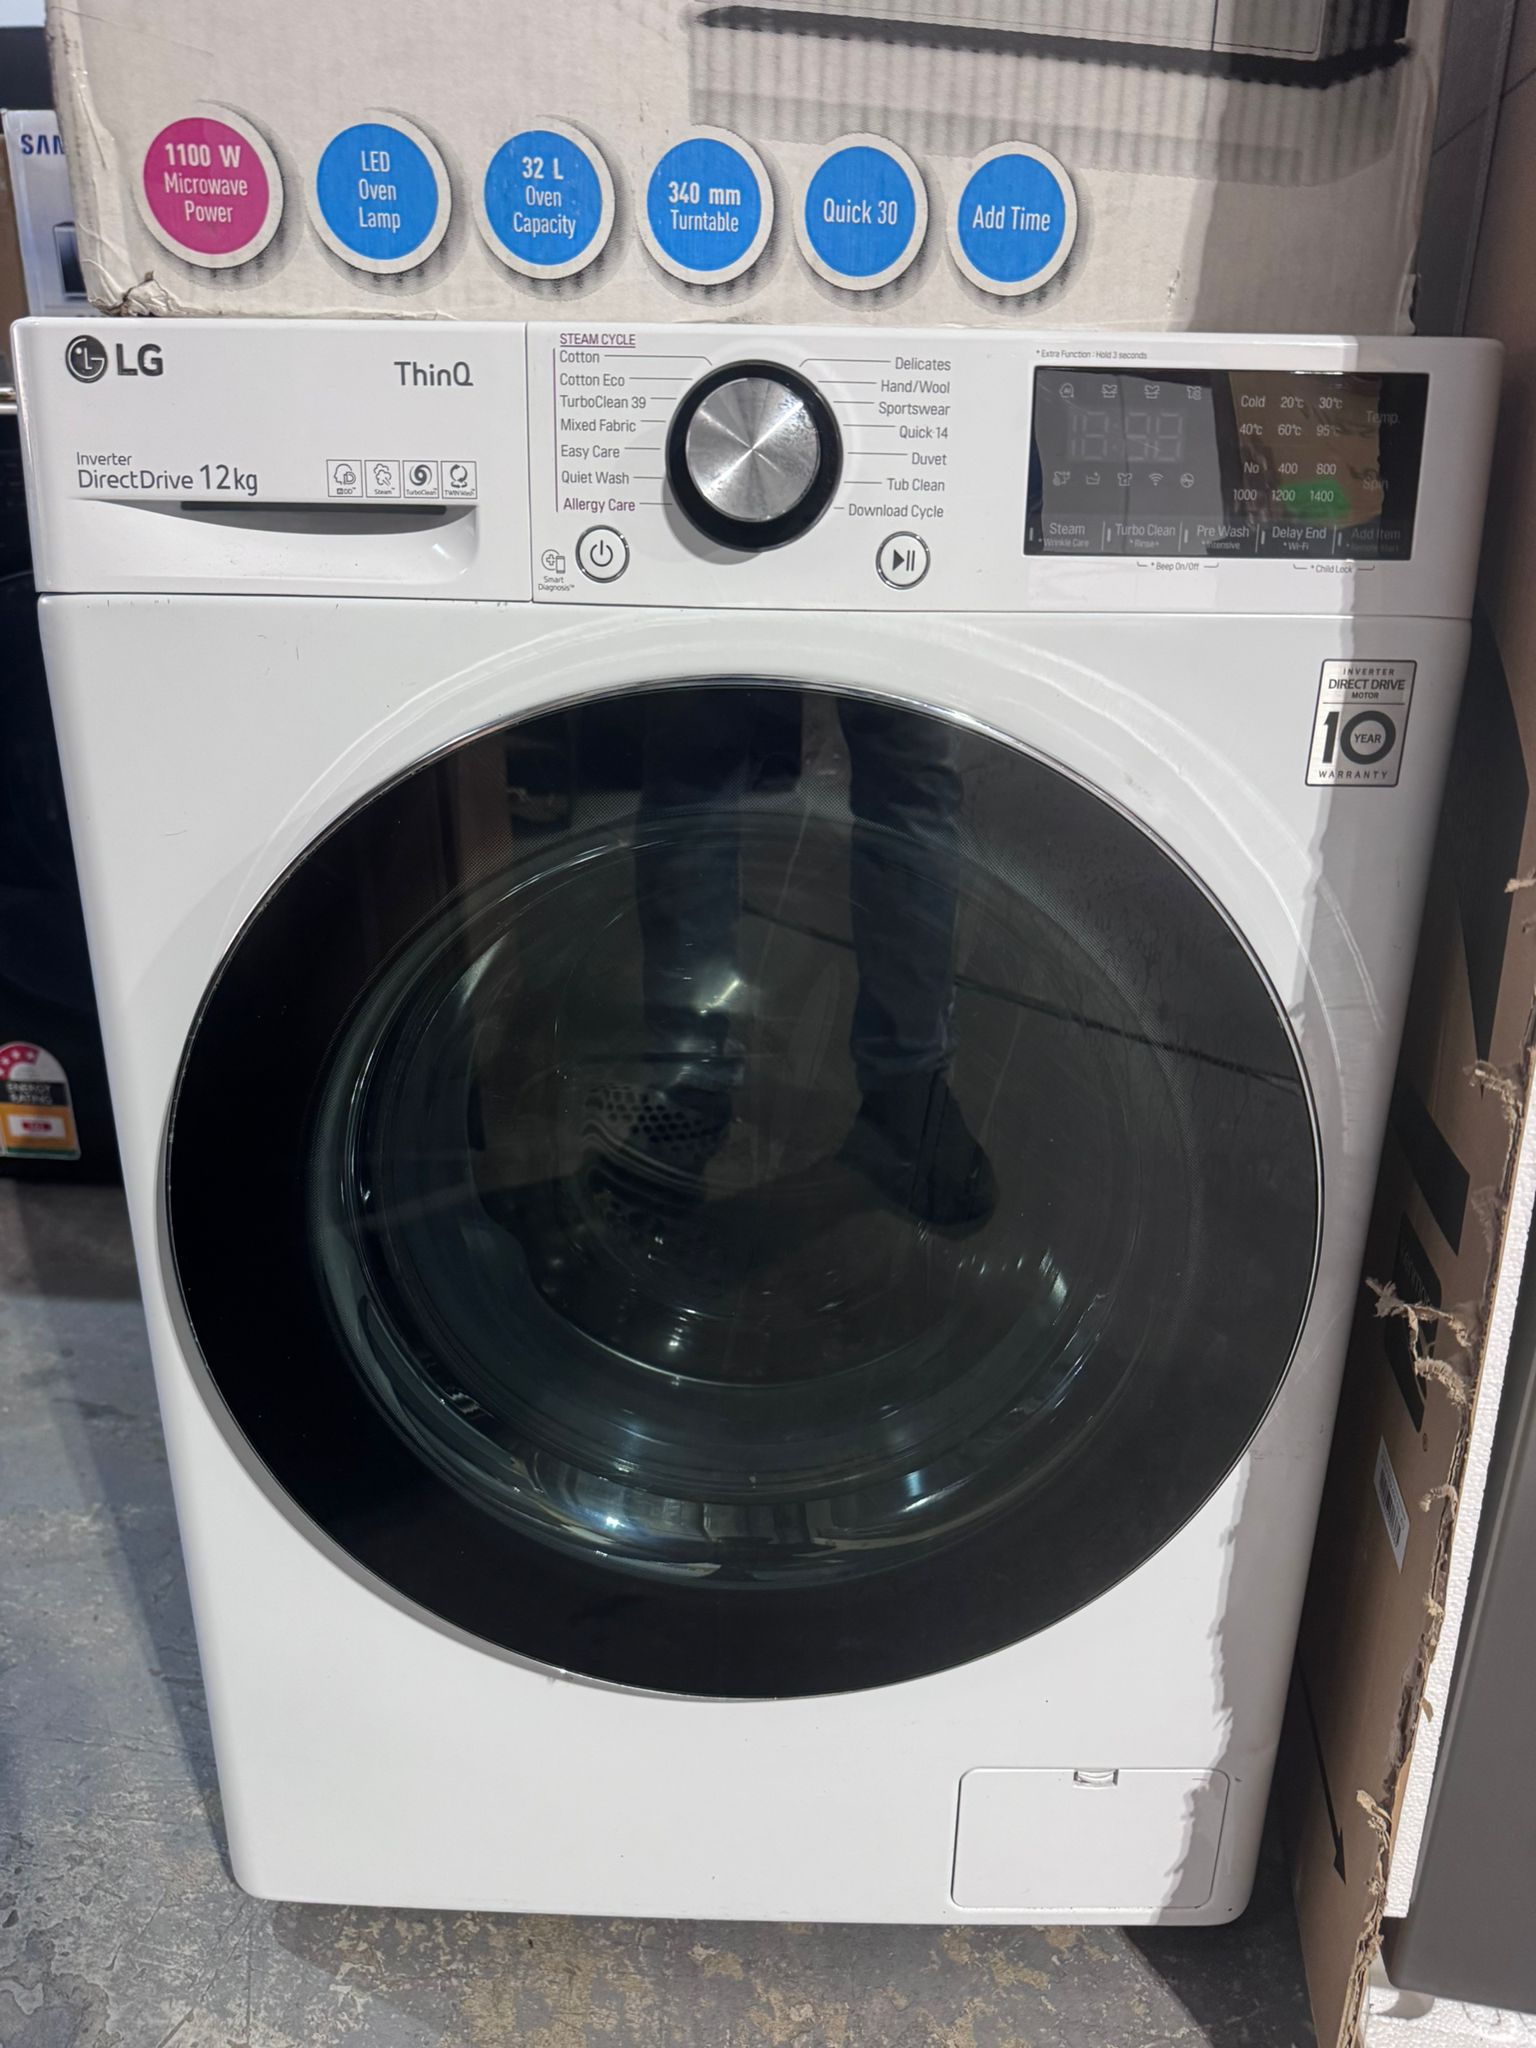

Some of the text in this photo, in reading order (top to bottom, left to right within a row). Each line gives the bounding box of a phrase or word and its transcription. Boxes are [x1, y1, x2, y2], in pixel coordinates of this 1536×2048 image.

[165, 143, 241, 168] 1100 W
[361, 151, 390, 173] LED
[522, 156, 564, 180] 32 L
[164, 172, 248, 196] Microwave
[358, 179, 396, 201] Oven
[525, 185, 562, 207] Oven
[668, 181, 741, 206] 340 mm
[184, 201, 233, 222] Power
[823, 198, 898, 225] Quick 30
[972, 204, 1051, 231] Add Time
[359, 207, 400, 233] Lamp
[513, 212, 576, 239] Capacity
[670, 208, 739, 232] Turntable
[560, 333, 636, 346] STEAM CYCLE
[116, 343, 164, 377] LG
[559, 350, 600, 363] Cotton
[1041, 349, 1060, 358] Extra
[1061, 350, 1092, 358] Function
[895, 357, 951, 371] Delicates
[394, 361, 474, 387] ThinQ
[560, 373, 625, 387] Cotton Eco
[881, 380, 950, 394] Hand/Wool
[560, 395, 646, 409] TurboClean 39
[878, 401, 950, 417] Sportswear
[1240, 395, 1266, 408] Cold
[560, 418, 636, 433] Mixed Fabric
[1366, 411, 1398, 426] Temp
[899, 425, 948, 440] Quick 14
[76, 451, 132, 466] Inverter
[561, 445, 620, 460] Easy Care
[911, 452, 947, 466] Duvet
[1244, 462, 1337, 475] No 400 800
[562, 471, 630, 485] Quiet Wash
[887, 478, 945, 492] Tub Clean
[1233, 489, 1334, 501] 1000 1200 1400
[563, 497, 635, 513] Allergy Care
[848, 504, 944, 520] Download Cycle
[1049, 522, 1086, 535] Steam
[1115, 523, 1176, 537] Turbo Clean
[1197, 524, 1250, 538] Pre Wash
[1272, 526, 1327, 541] Delay End
[1156, 562, 1200, 571] Beep On/Off
[1315, 565, 1353, 574] Child Lock
[1343, 668, 1395, 676] INVERTER
[1328, 678, 1406, 690] DIRECT DRIVE
[1322, 710, 1396, 765] 10
[1354, 733, 1382, 744] YEAR
[1319, 770, 1388, 779] WARRANTY
